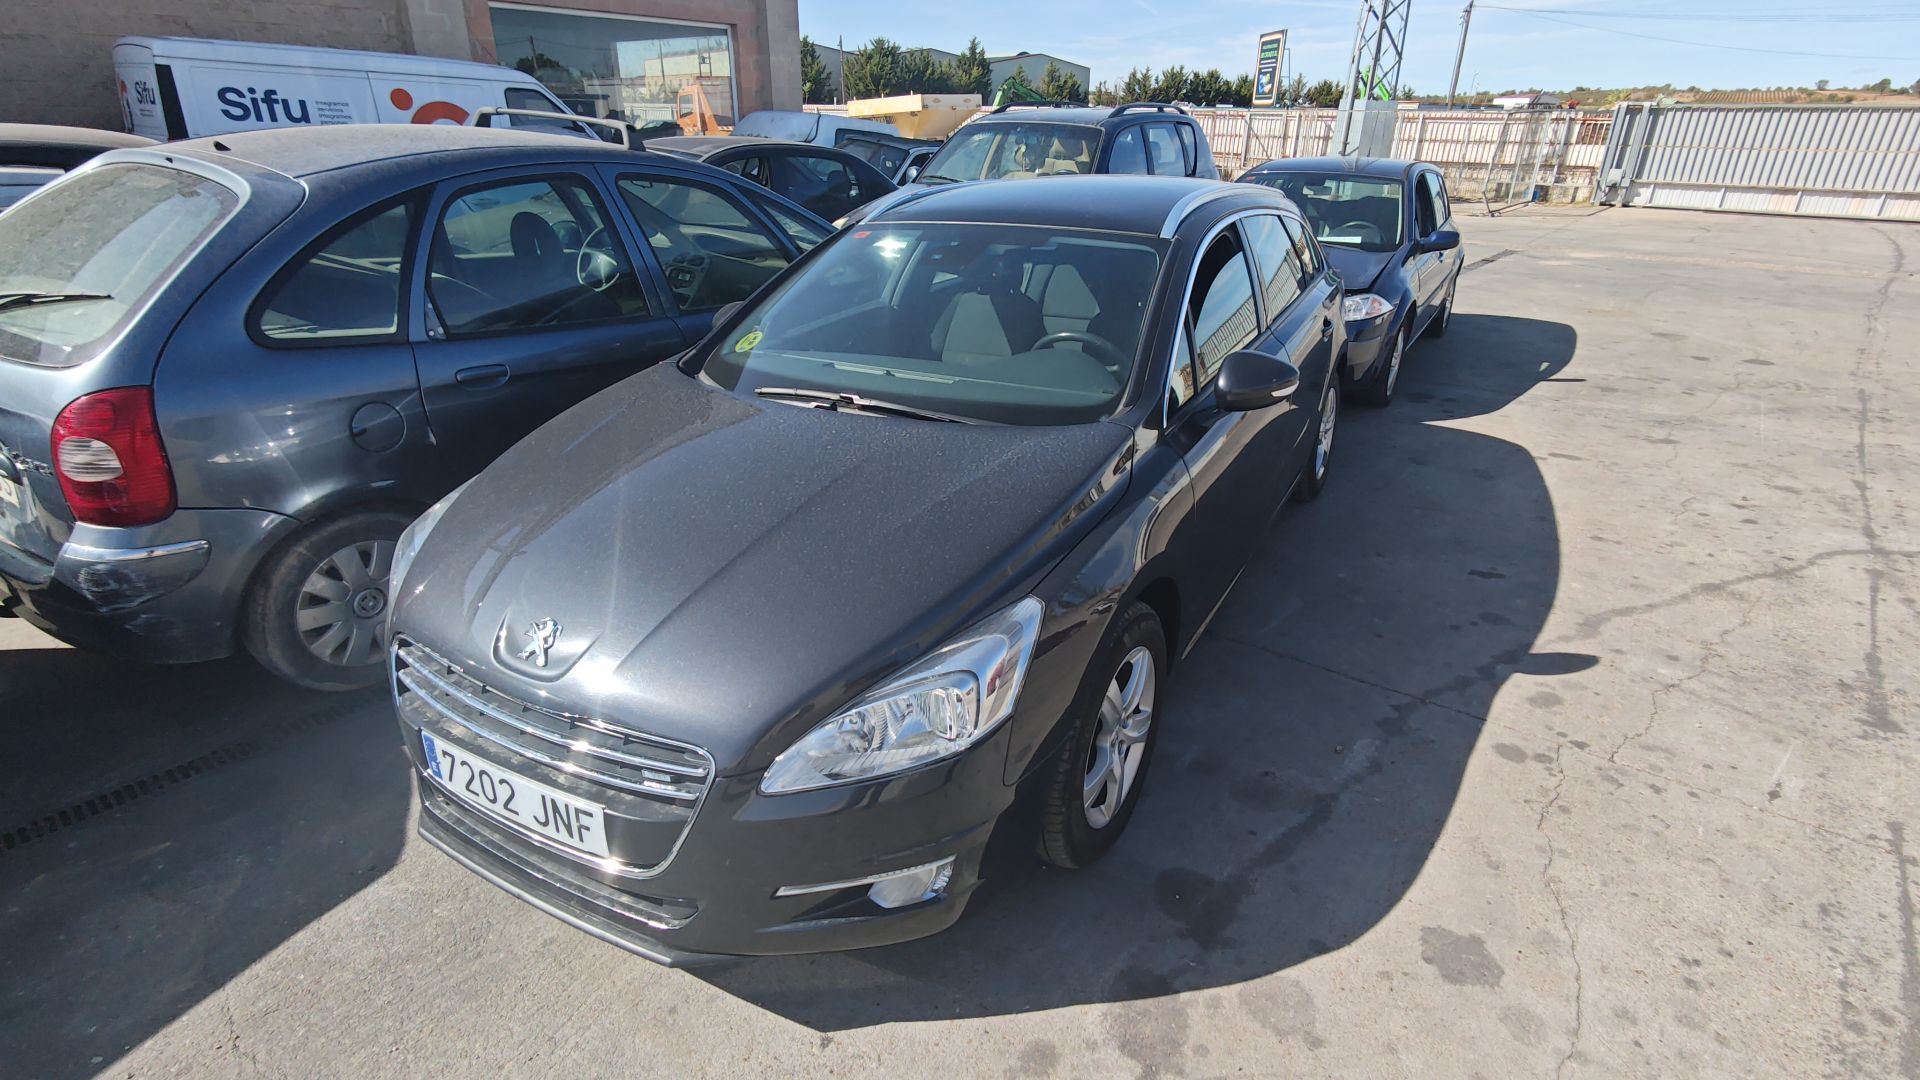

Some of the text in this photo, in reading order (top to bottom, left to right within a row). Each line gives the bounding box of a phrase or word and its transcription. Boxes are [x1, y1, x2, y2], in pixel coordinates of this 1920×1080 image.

[135, 81, 156, 105] Sifu
[217, 87, 311, 124] Sifu
[441, 750, 594, 843] 7202 JNF
